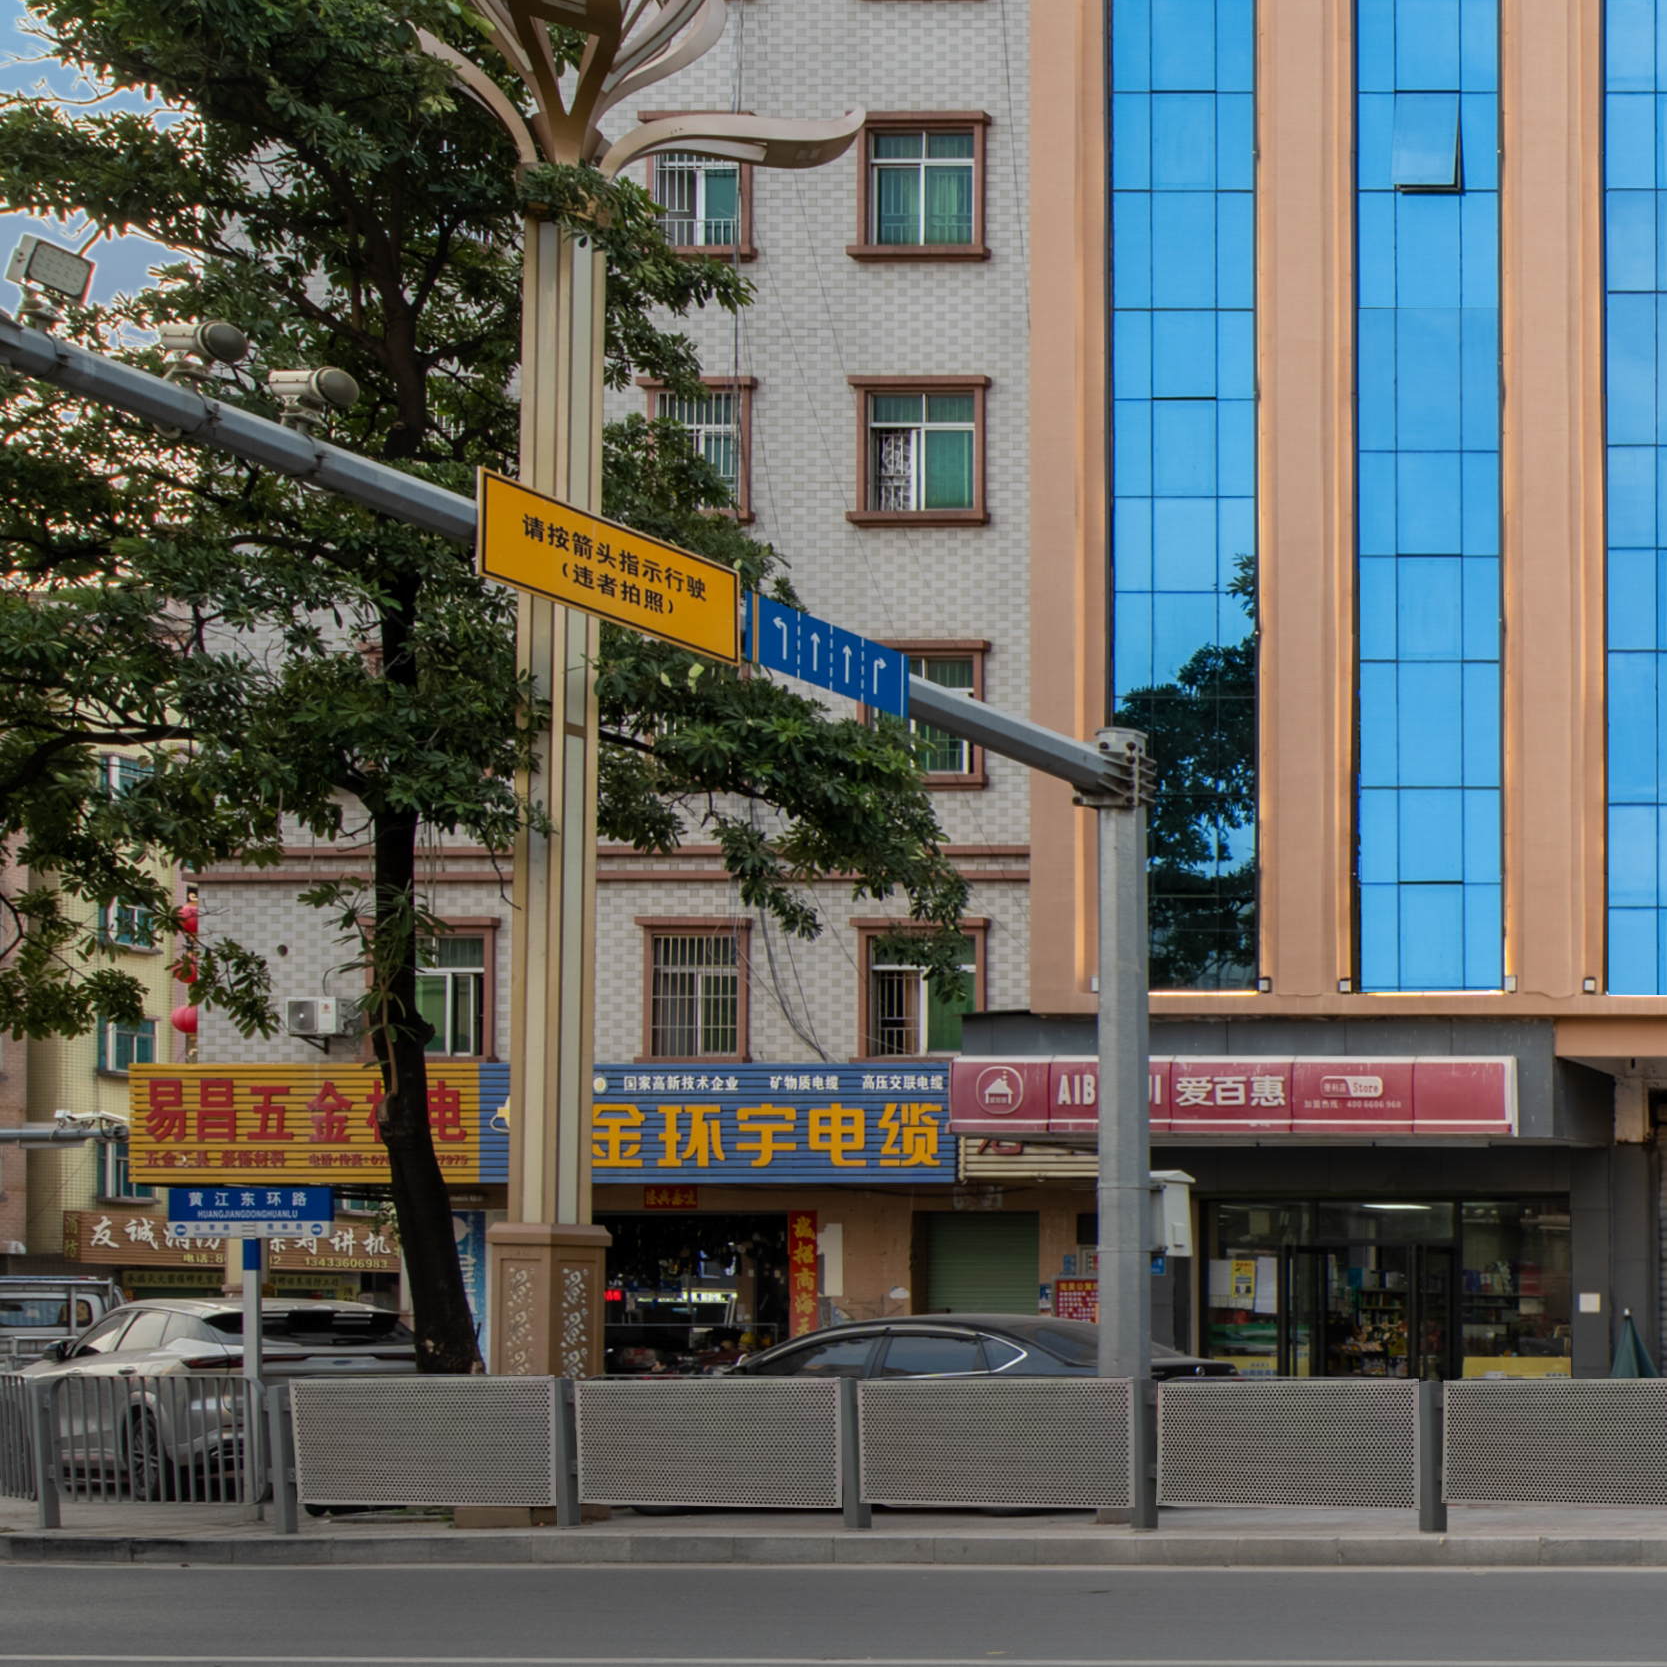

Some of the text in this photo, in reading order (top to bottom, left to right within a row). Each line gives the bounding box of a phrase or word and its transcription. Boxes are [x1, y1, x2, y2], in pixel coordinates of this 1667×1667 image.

[521, 513, 707, 602] 请按箭头指示行驶
[623, 1074, 944, 1092] 国家高新技术企业 矿物质电缆 高压交联电缆
[1175, 1075, 1286, 1107] 爱百惠
[1323, 1082, 1379, 1094] 便利店 Store
[1346, 1100, 1363, 1109] 400
[592, 1102, 944, 1168] 金环宇电缆
[188, 1191, 307, 1207] 黄江东环路
[197, 1209, 298, 1219] HUANGJIANGDONGHUANLU
[304, 1256, 389, 1269] 13433606983
